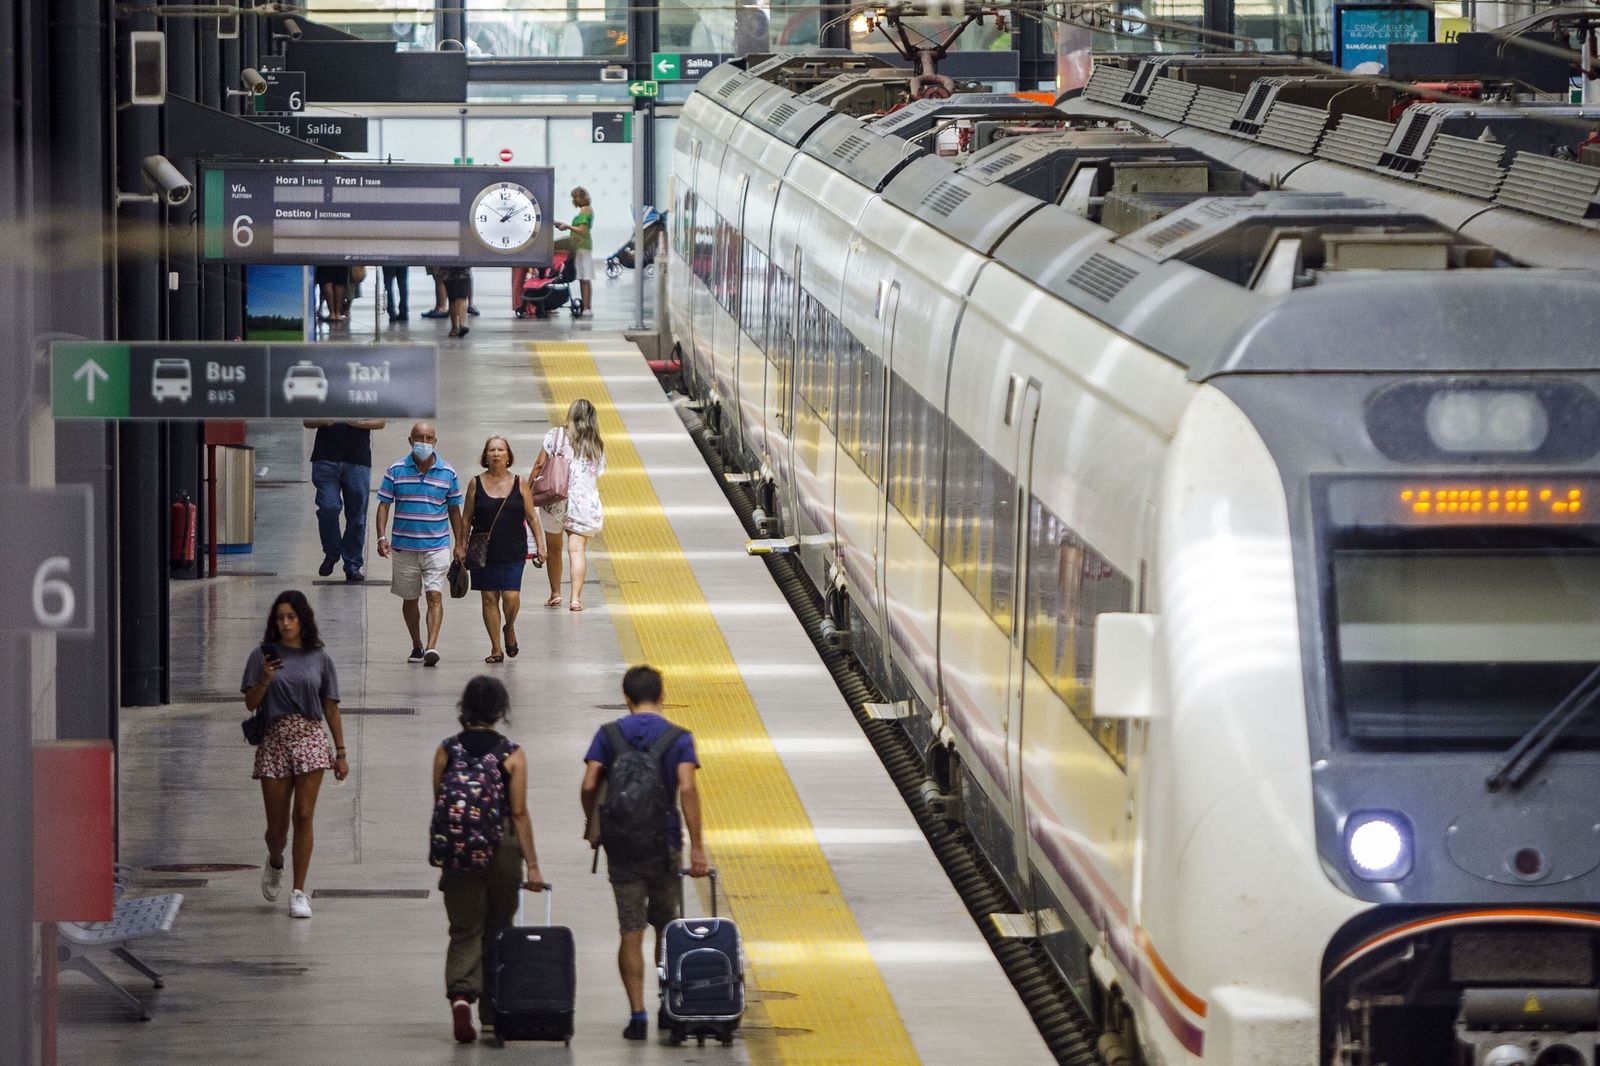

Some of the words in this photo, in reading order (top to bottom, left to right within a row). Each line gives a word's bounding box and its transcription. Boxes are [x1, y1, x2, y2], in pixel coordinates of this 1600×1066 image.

[687, 59, 713, 67] Salida
[289, 91, 301, 110] 6
[306, 123, 342, 135] Salida
[594, 126, 605, 142] 6
[275, 176, 299, 185] Hora
[335, 176, 357, 185] Tren
[275, 209, 312, 218] Destino
[232, 214, 254, 247] 6
[206, 361, 246, 381] Bus
[348, 360, 391, 382] Taxi
[208, 389, 236, 402] BUS
[348, 390, 378, 402] TAXI
[32, 555, 76, 627] 6
